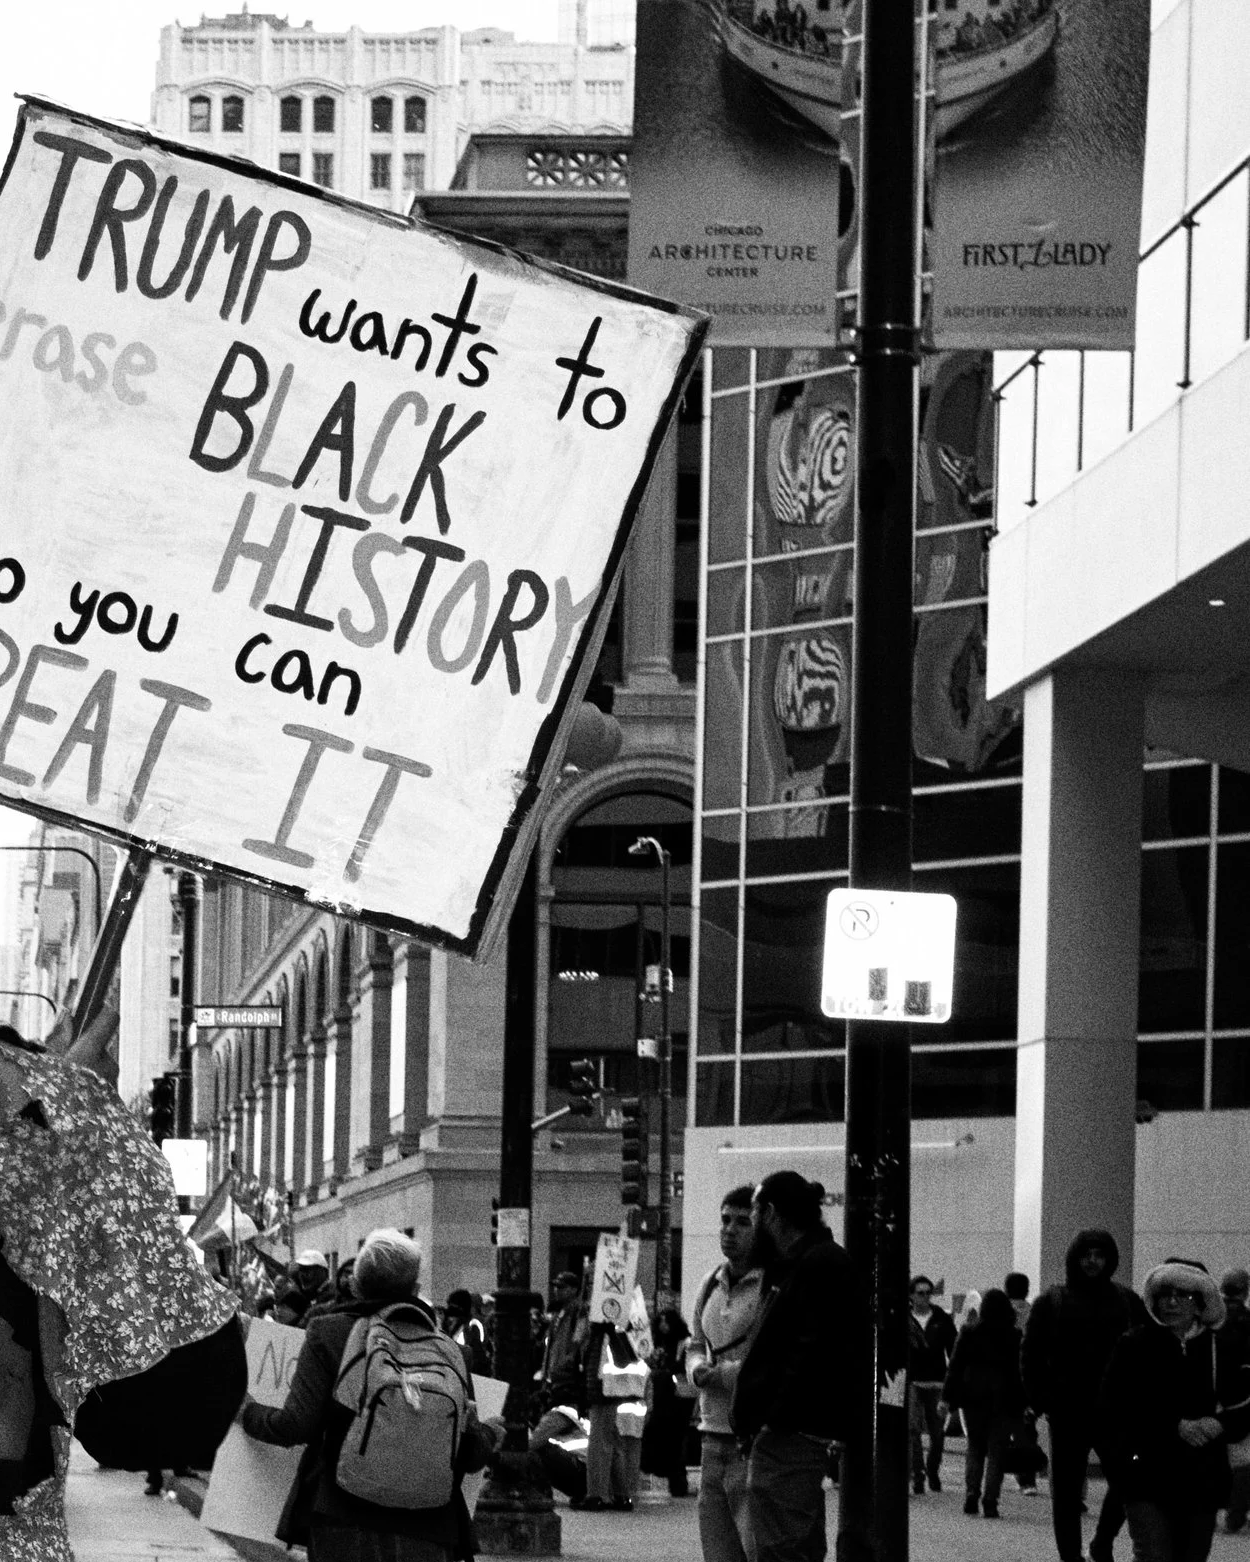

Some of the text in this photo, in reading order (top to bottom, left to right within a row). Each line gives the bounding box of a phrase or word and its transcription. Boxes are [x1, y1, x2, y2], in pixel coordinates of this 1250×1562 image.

[31, 129, 628, 430] TRUMP wants to
[650, 243, 818, 262] ARCHITECTURE
[705, 226, 763, 236] CHICAGO
[707, 266, 759, 278] CENTER
[188, 340, 486, 536] BLACK
[54, 581, 180, 652] you
[234, 631, 363, 716] can
[211, 491, 600, 705] HISTORY
[242, 723, 433, 884] IT
[221, 1010, 270, 1025] Randolph
